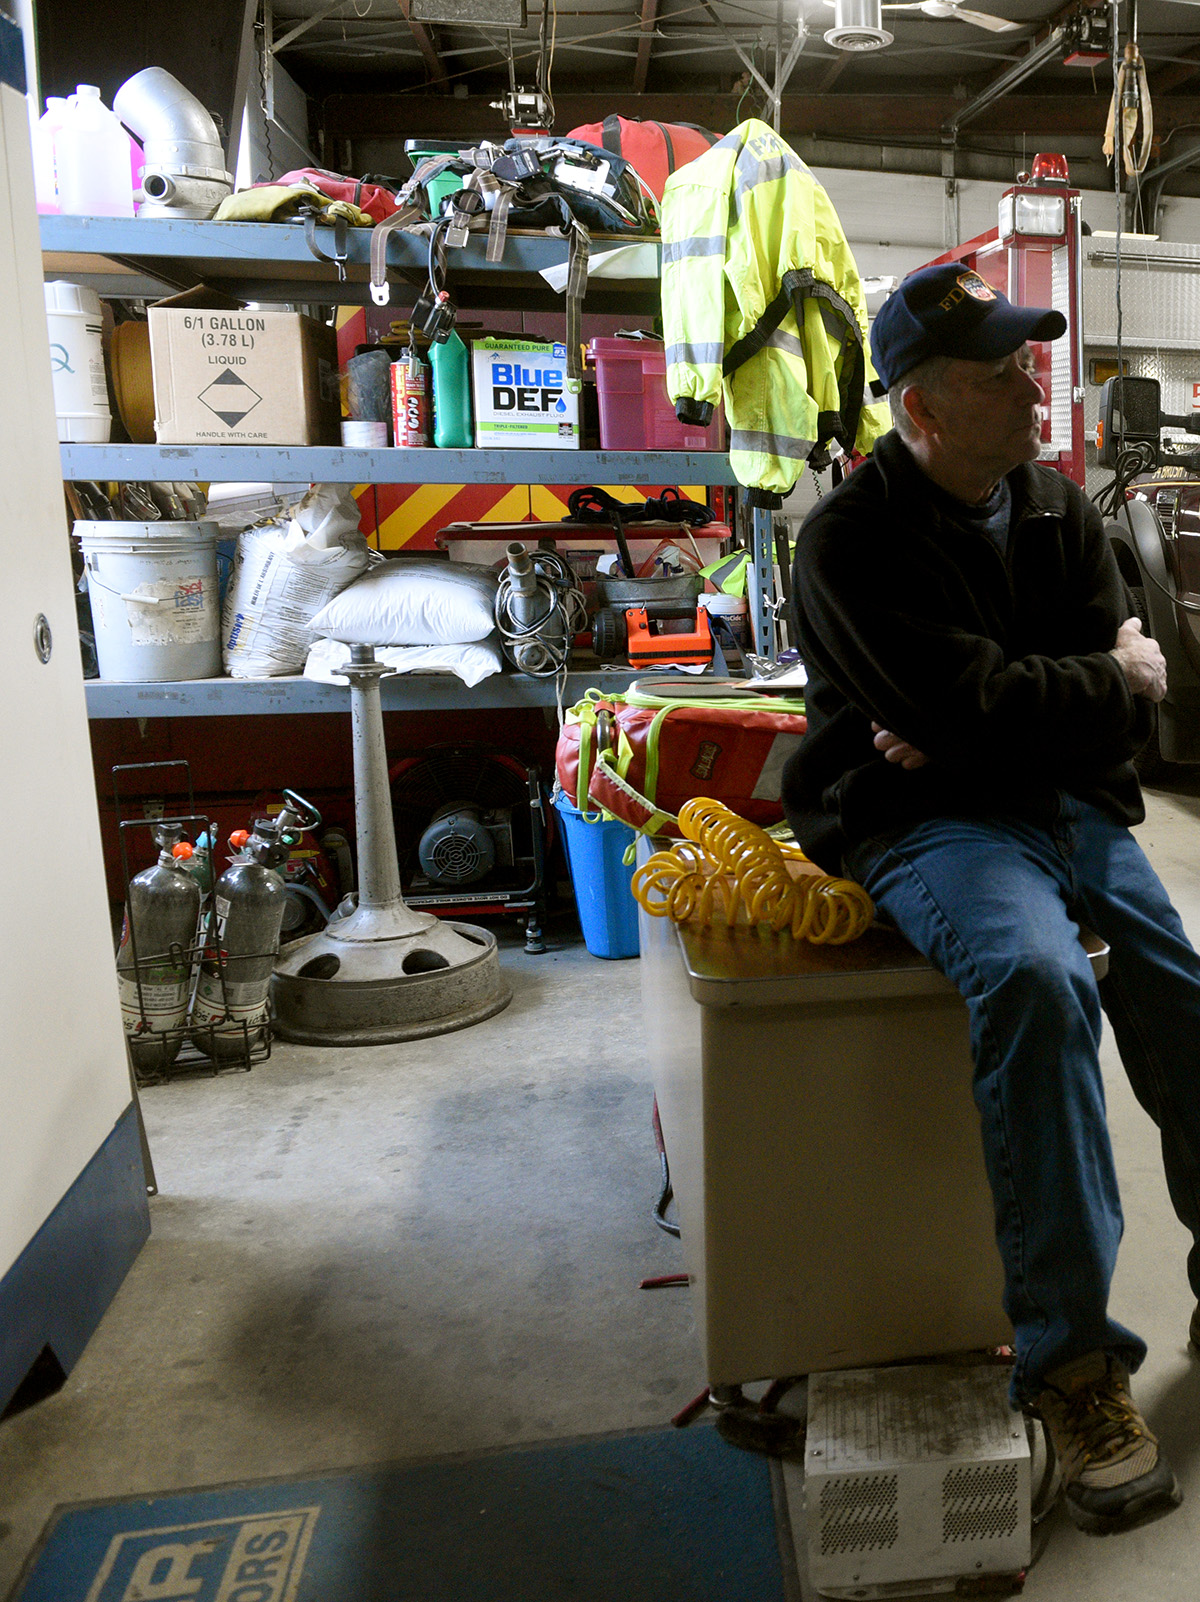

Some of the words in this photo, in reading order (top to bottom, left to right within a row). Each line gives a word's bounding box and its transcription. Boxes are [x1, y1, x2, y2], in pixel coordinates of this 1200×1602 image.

[183, 316, 204, 330] 6/1
[209, 316, 266, 332] GALLON
[201, 332, 238, 349] (3.78
[240, 334, 255, 350] L)
[484, 343, 532, 351] GUARANTEED
[207, 355, 247, 366] LIQUID
[491, 362, 563, 388] Blue
[395, 364, 408, 444] TRUFUEL
[492, 386, 564, 412] DEF
[515, 411, 545, 419] EXHAUST
